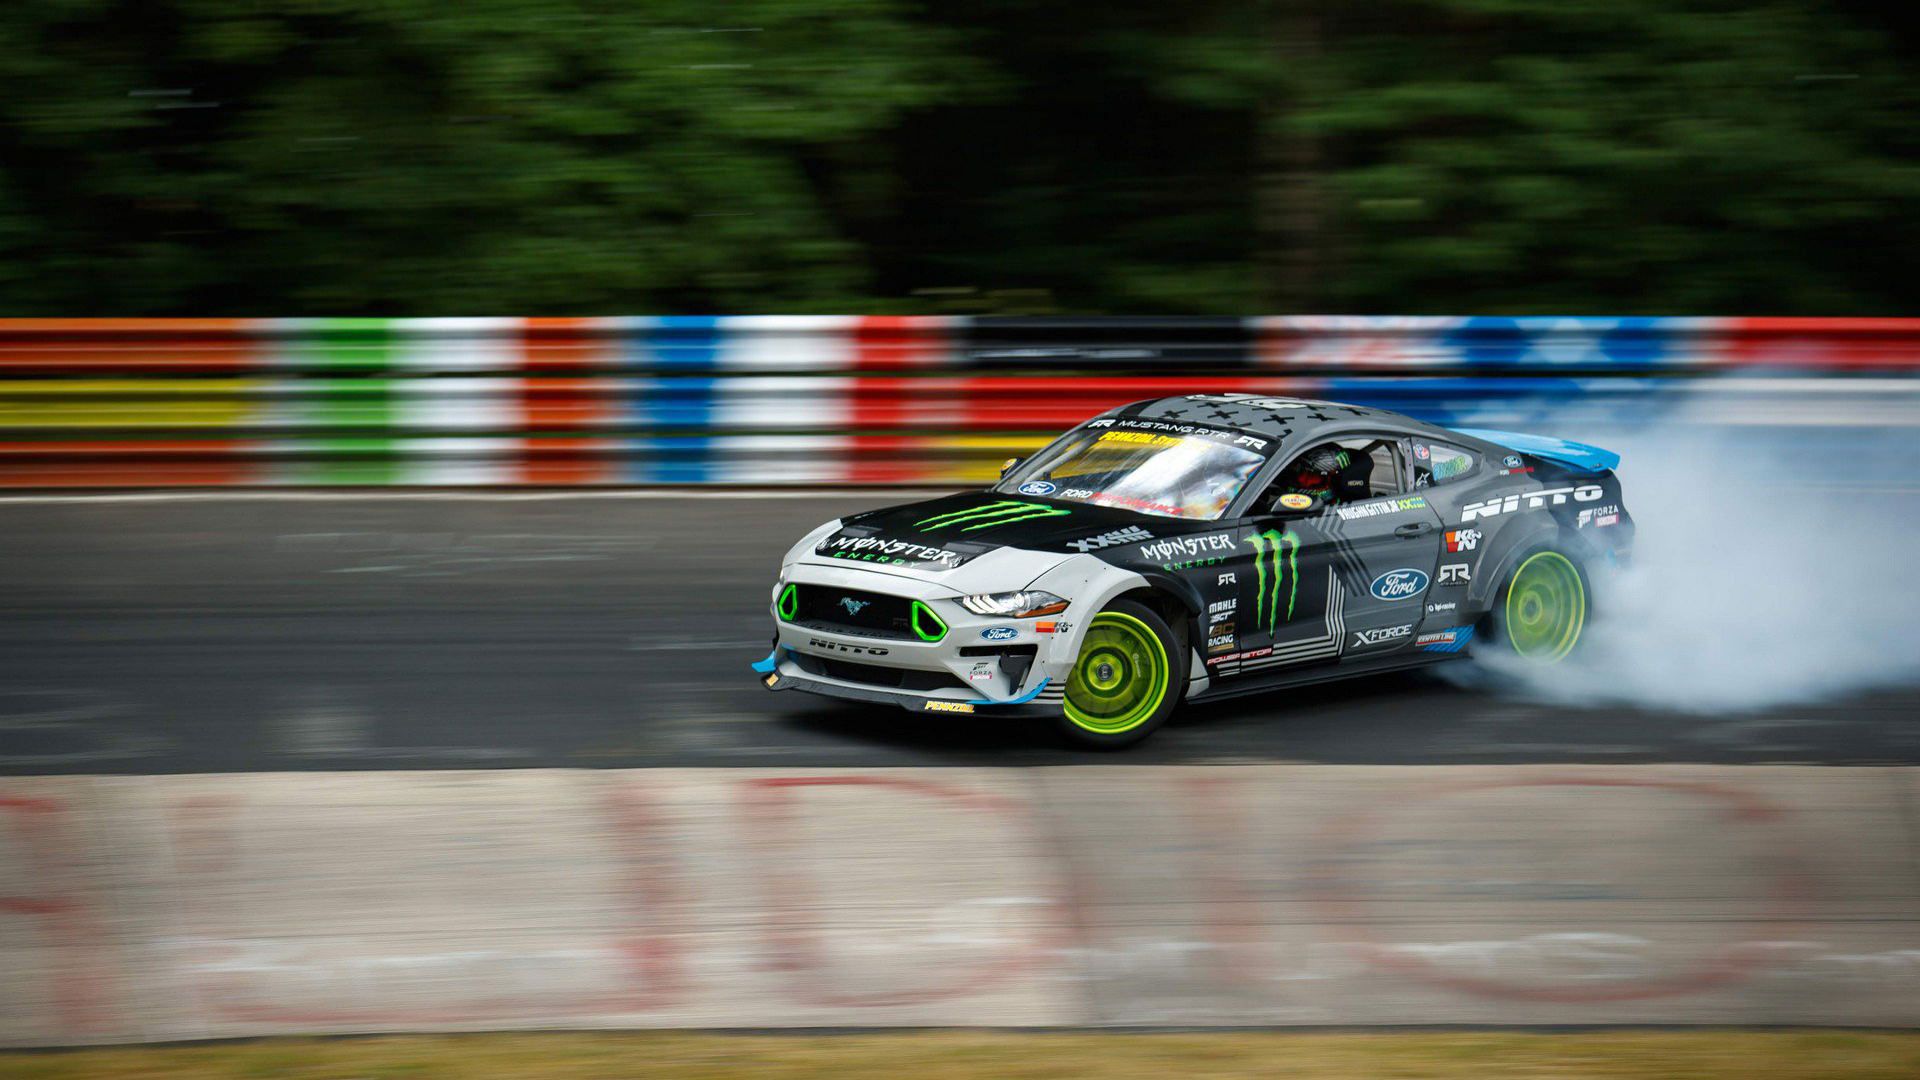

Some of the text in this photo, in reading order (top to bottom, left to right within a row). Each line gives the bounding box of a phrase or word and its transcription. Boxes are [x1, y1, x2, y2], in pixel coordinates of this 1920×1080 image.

[1118, 420, 1194, 433] MUSTANG
[1195, 427, 1231, 439] RTR
[1022, 483, 1050, 495] Ford
[1461, 485, 1603, 522] NITTO
[1593, 504, 1619, 517] FORZA
[833, 551, 920, 567] ENERGY
[1163, 555, 1227, 571] ENERGY
[1381, 573, 1418, 596] Ford
[1209, 599, 1237, 614] MAHLE
[987, 628, 1012, 639] Ford
[1208, 634, 1234, 648] RACING
[810, 638, 889, 656] NITTO
[925, 700, 975, 713] PENNZOIL
